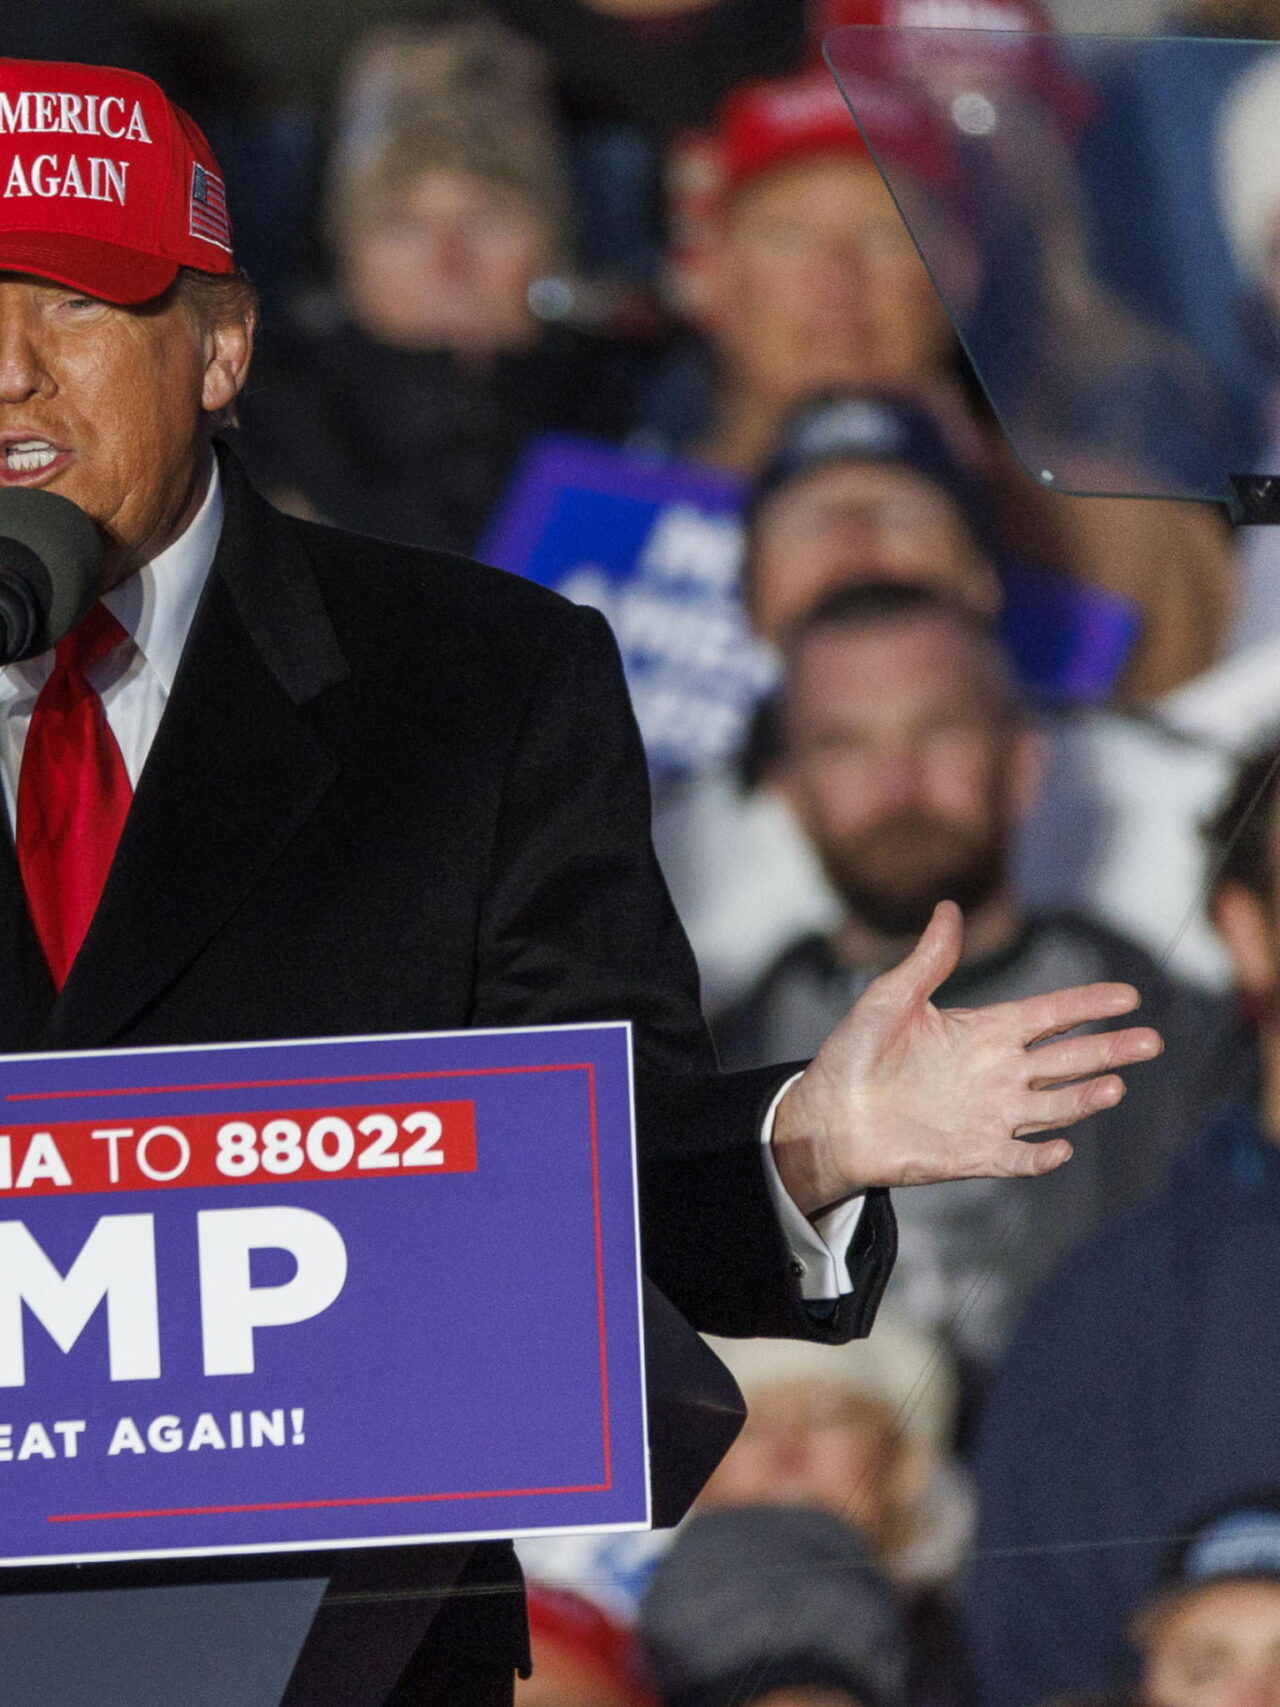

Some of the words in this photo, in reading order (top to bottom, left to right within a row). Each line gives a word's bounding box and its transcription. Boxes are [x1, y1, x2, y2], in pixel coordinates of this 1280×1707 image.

[2, 154, 130, 206] AGAIN
[91, 1125, 190, 1183] TO
[216, 1111, 444, 1177] 88022
[107, 1407, 307, 1456] AGAIN!
